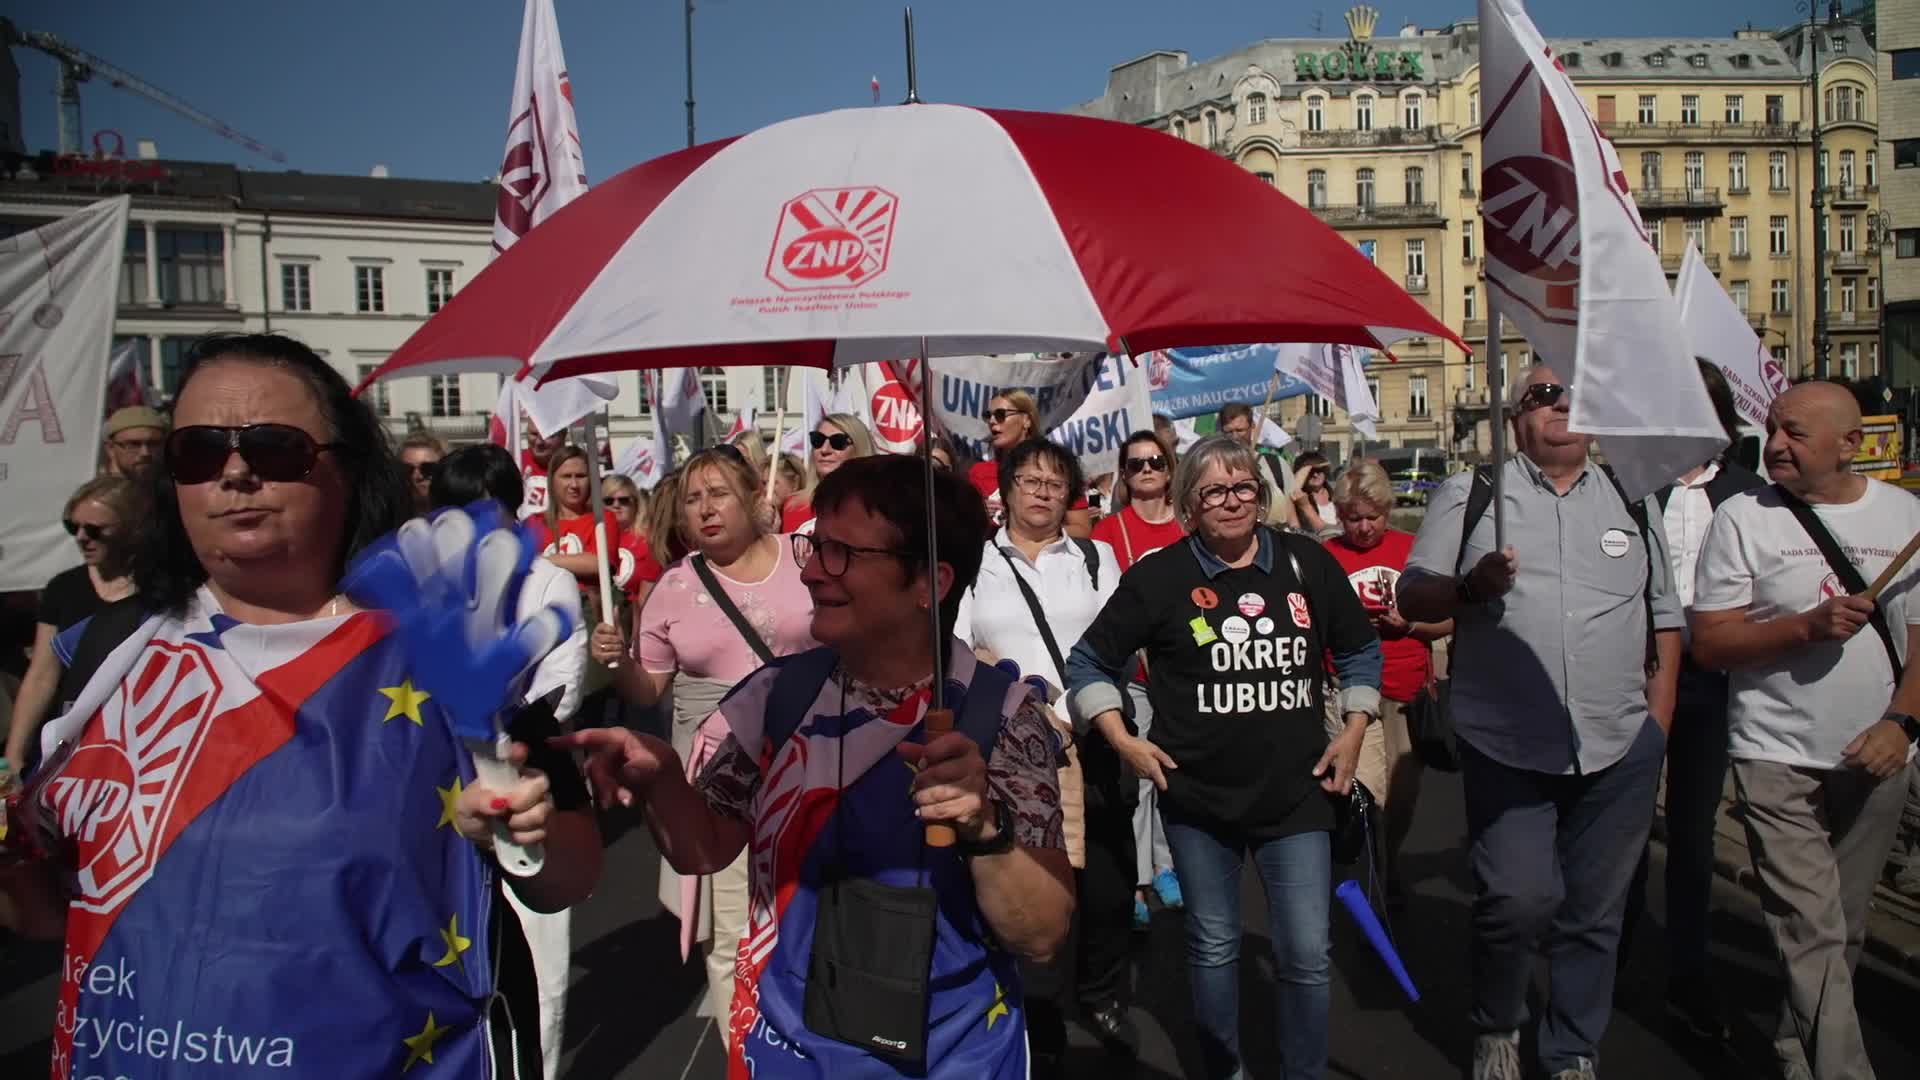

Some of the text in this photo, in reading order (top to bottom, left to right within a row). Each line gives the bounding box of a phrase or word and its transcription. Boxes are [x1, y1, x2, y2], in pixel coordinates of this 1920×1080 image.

[1295, 50, 1425, 80] ROLEX
[786, 239, 862, 269] ZNP
[1211, 636, 1307, 675] OKRĘG
